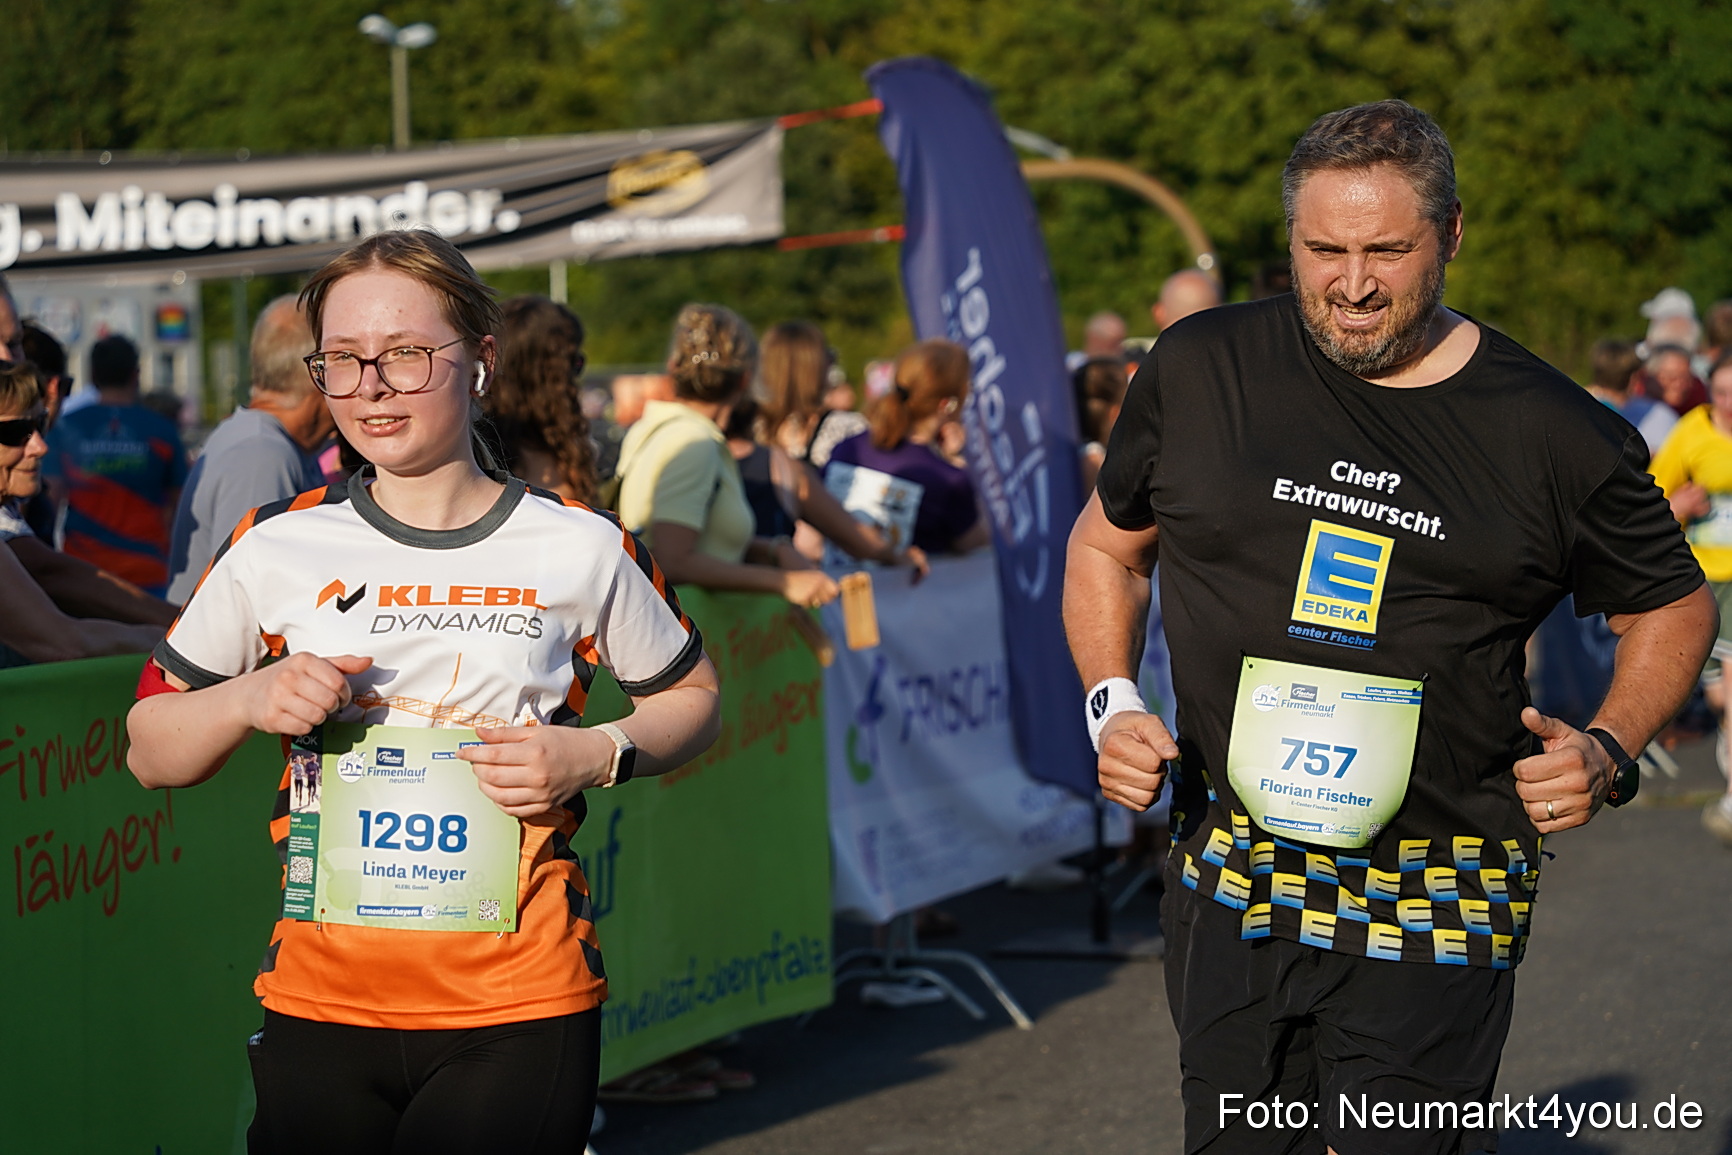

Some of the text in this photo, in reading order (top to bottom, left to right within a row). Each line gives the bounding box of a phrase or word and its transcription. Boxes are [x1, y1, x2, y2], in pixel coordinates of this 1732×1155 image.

[54, 182, 521, 252] Miteinander.
[1330, 459, 1402, 495] Chef?
[1272, 477, 1447, 541] Extrawurscht.
[377, 585, 548, 611] KLEBL
[1301, 599, 1370, 624] EDEKA
[369, 612, 544, 640] DYNAMICS
[1287, 624, 1377, 648] center Fischer
[1281, 699, 1336, 712] Firmenlauf
[1301, 710, 1334, 719] neumarkt
[295, 735, 318, 746] AOK
[1280, 737, 1358, 779] 757
[367, 766, 427, 777] Firmenlauf
[1259, 778, 1373, 808] Florian Fischer
[1312, 803, 1331, 811] Fischer
[358, 809, 468, 853] 1298
[1266, 817, 1320, 831] firmenlauf.bayern
[14, 788, 182, 918] länger!
[362, 861, 467, 884] Linda Meyer
[359, 906, 420, 917] firmenlauf.bayern
